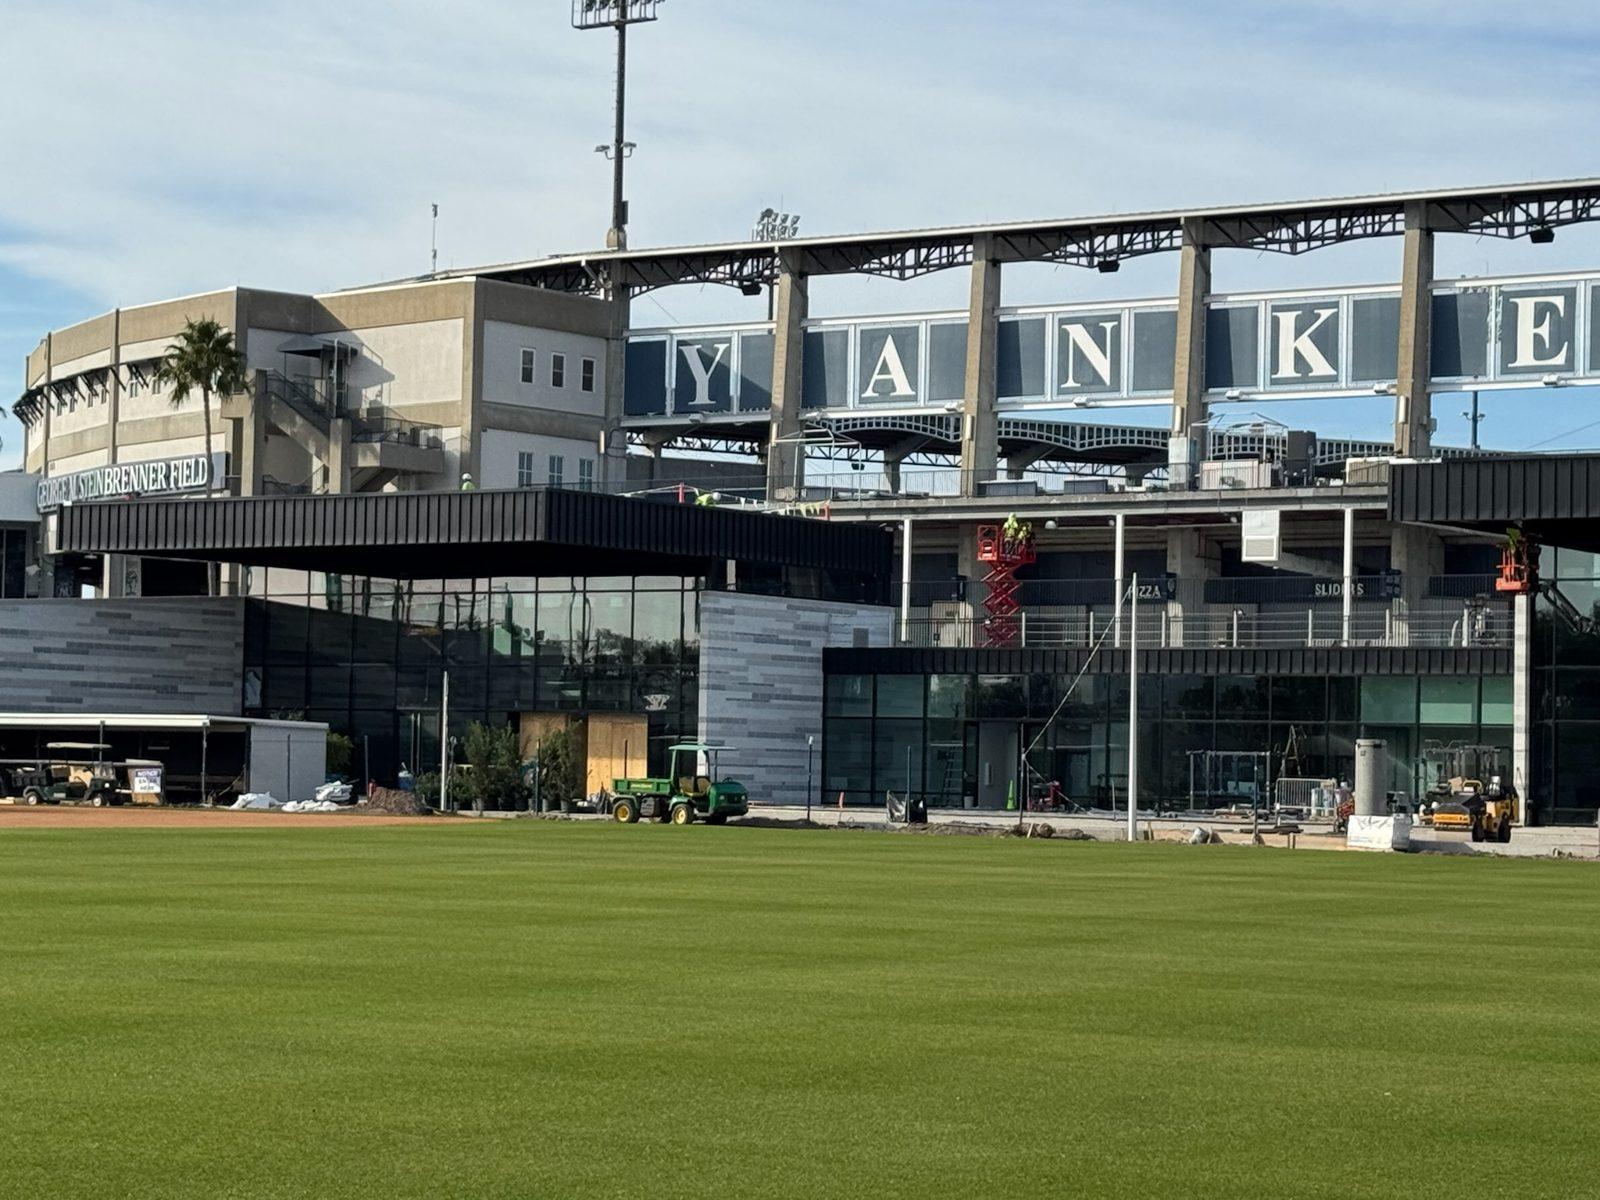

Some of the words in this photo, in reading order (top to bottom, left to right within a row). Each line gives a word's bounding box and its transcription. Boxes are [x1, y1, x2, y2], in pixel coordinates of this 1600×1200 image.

[37, 477, 68, 508] GEORGE
[79, 461, 167, 500] STEINBRENNER
[169, 457, 208, 489] FIELD
[1315, 583, 1364, 596] SLIDRS
